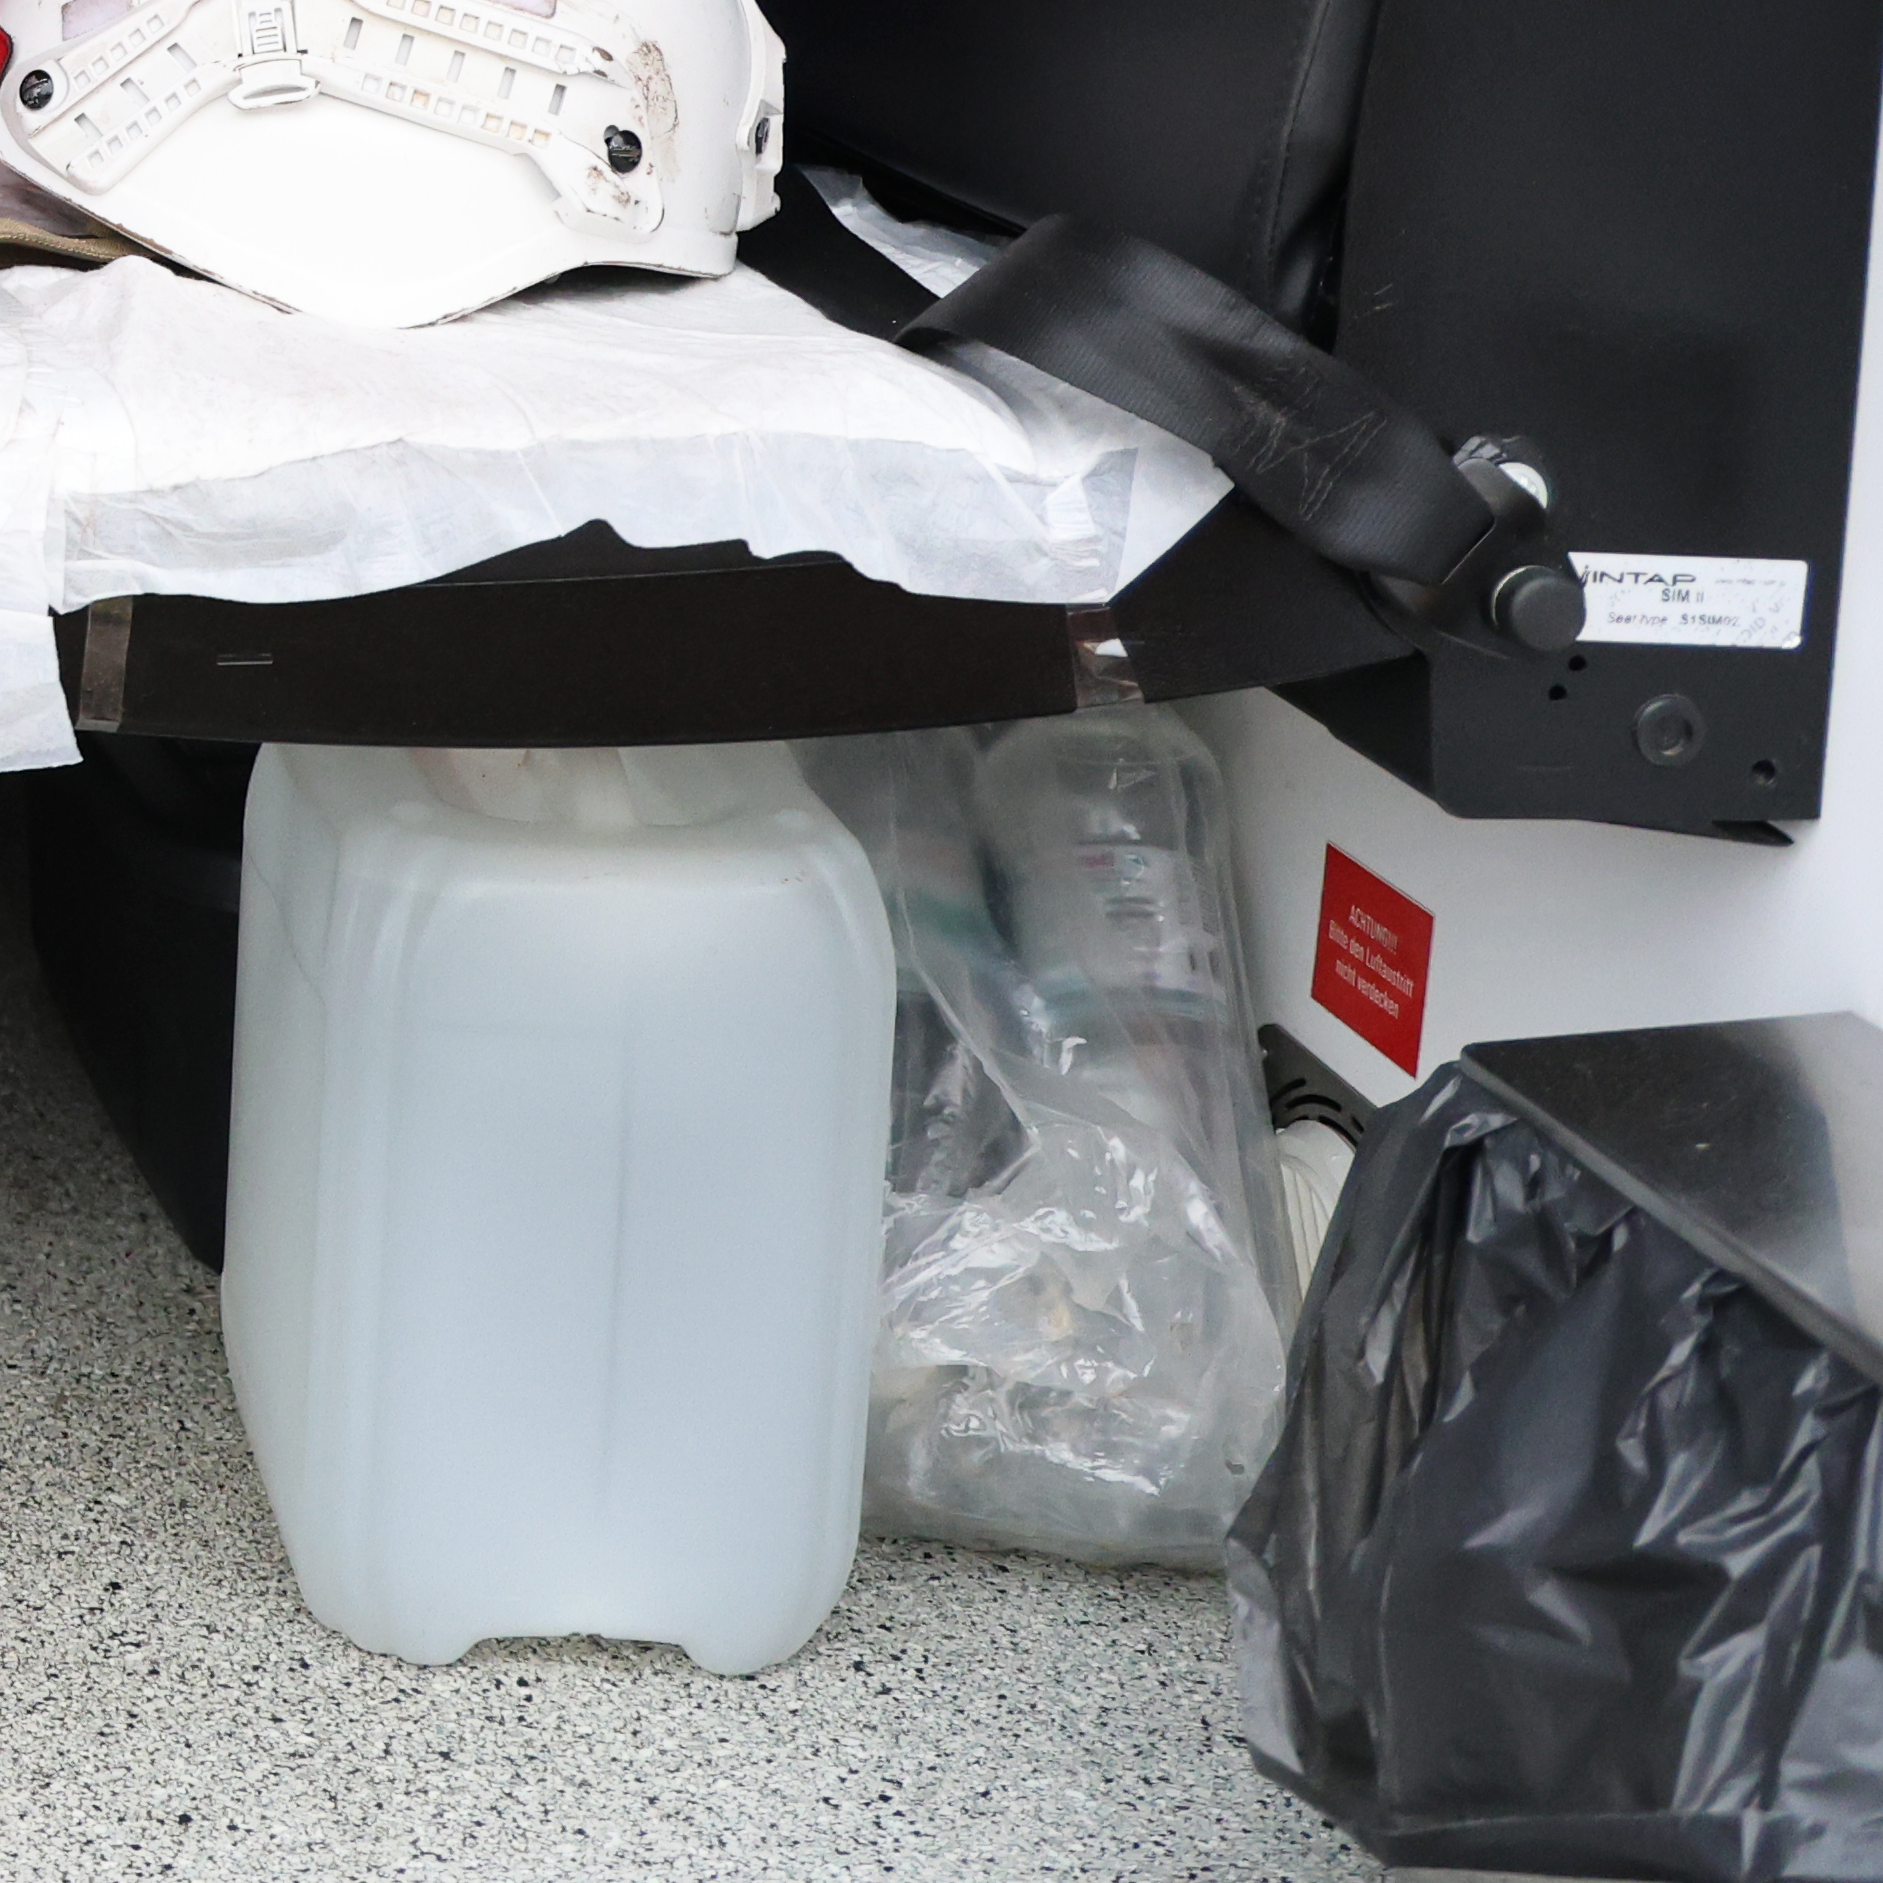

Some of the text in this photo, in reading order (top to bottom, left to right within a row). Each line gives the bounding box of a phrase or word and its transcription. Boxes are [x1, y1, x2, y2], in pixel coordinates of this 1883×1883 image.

[1661, 587, 1691, 604] SIM
[1348, 904, 1398, 955] ACHTUNG!!!
[1328, 919, 1415, 998] Bitte den Luftaustritt
[1335, 959, 1400, 1019] nicht verdecken
